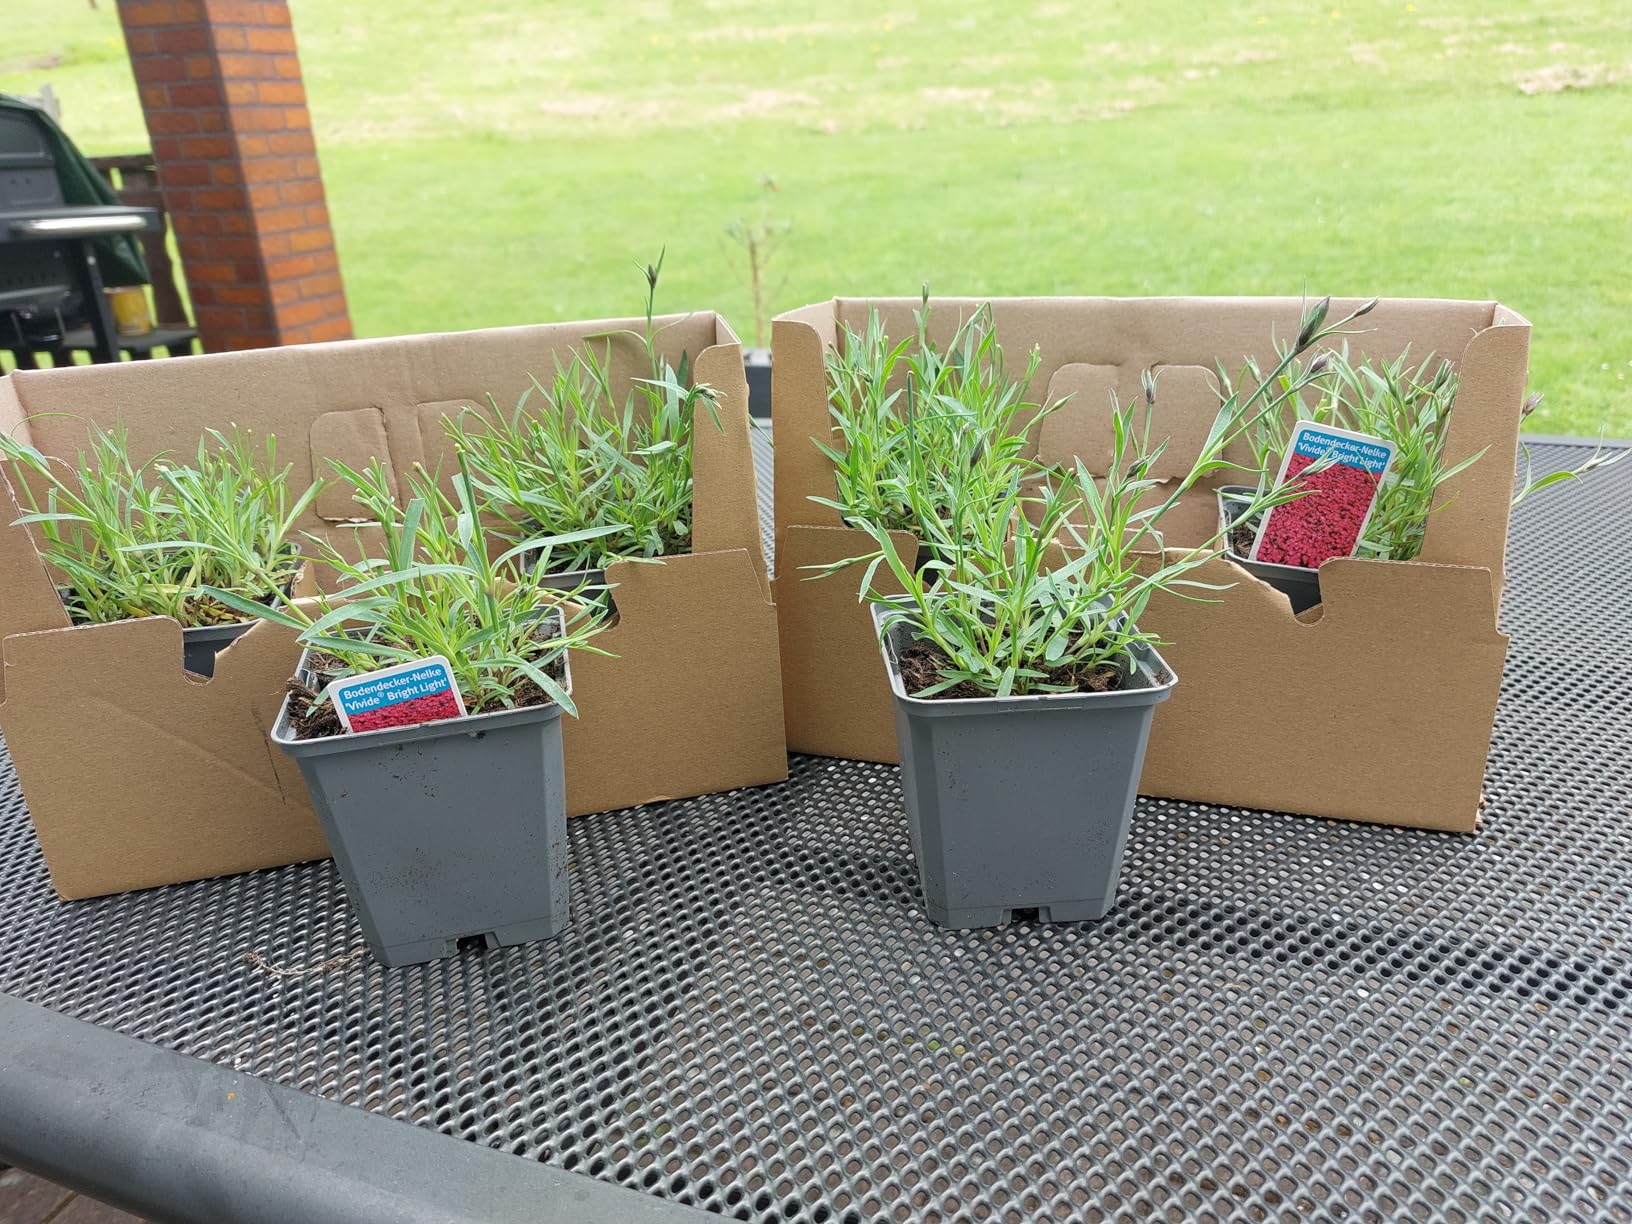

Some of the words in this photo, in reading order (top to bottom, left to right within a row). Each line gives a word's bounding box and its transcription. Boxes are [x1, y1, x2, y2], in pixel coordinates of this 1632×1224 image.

[1303, 433, 1386, 458] Bodendecker-Nelke
[1332, 451, 1359, 464] Bright
[344, 668, 441, 699] Bodendecker-Nelke
[387, 686, 418, 701] Bright
